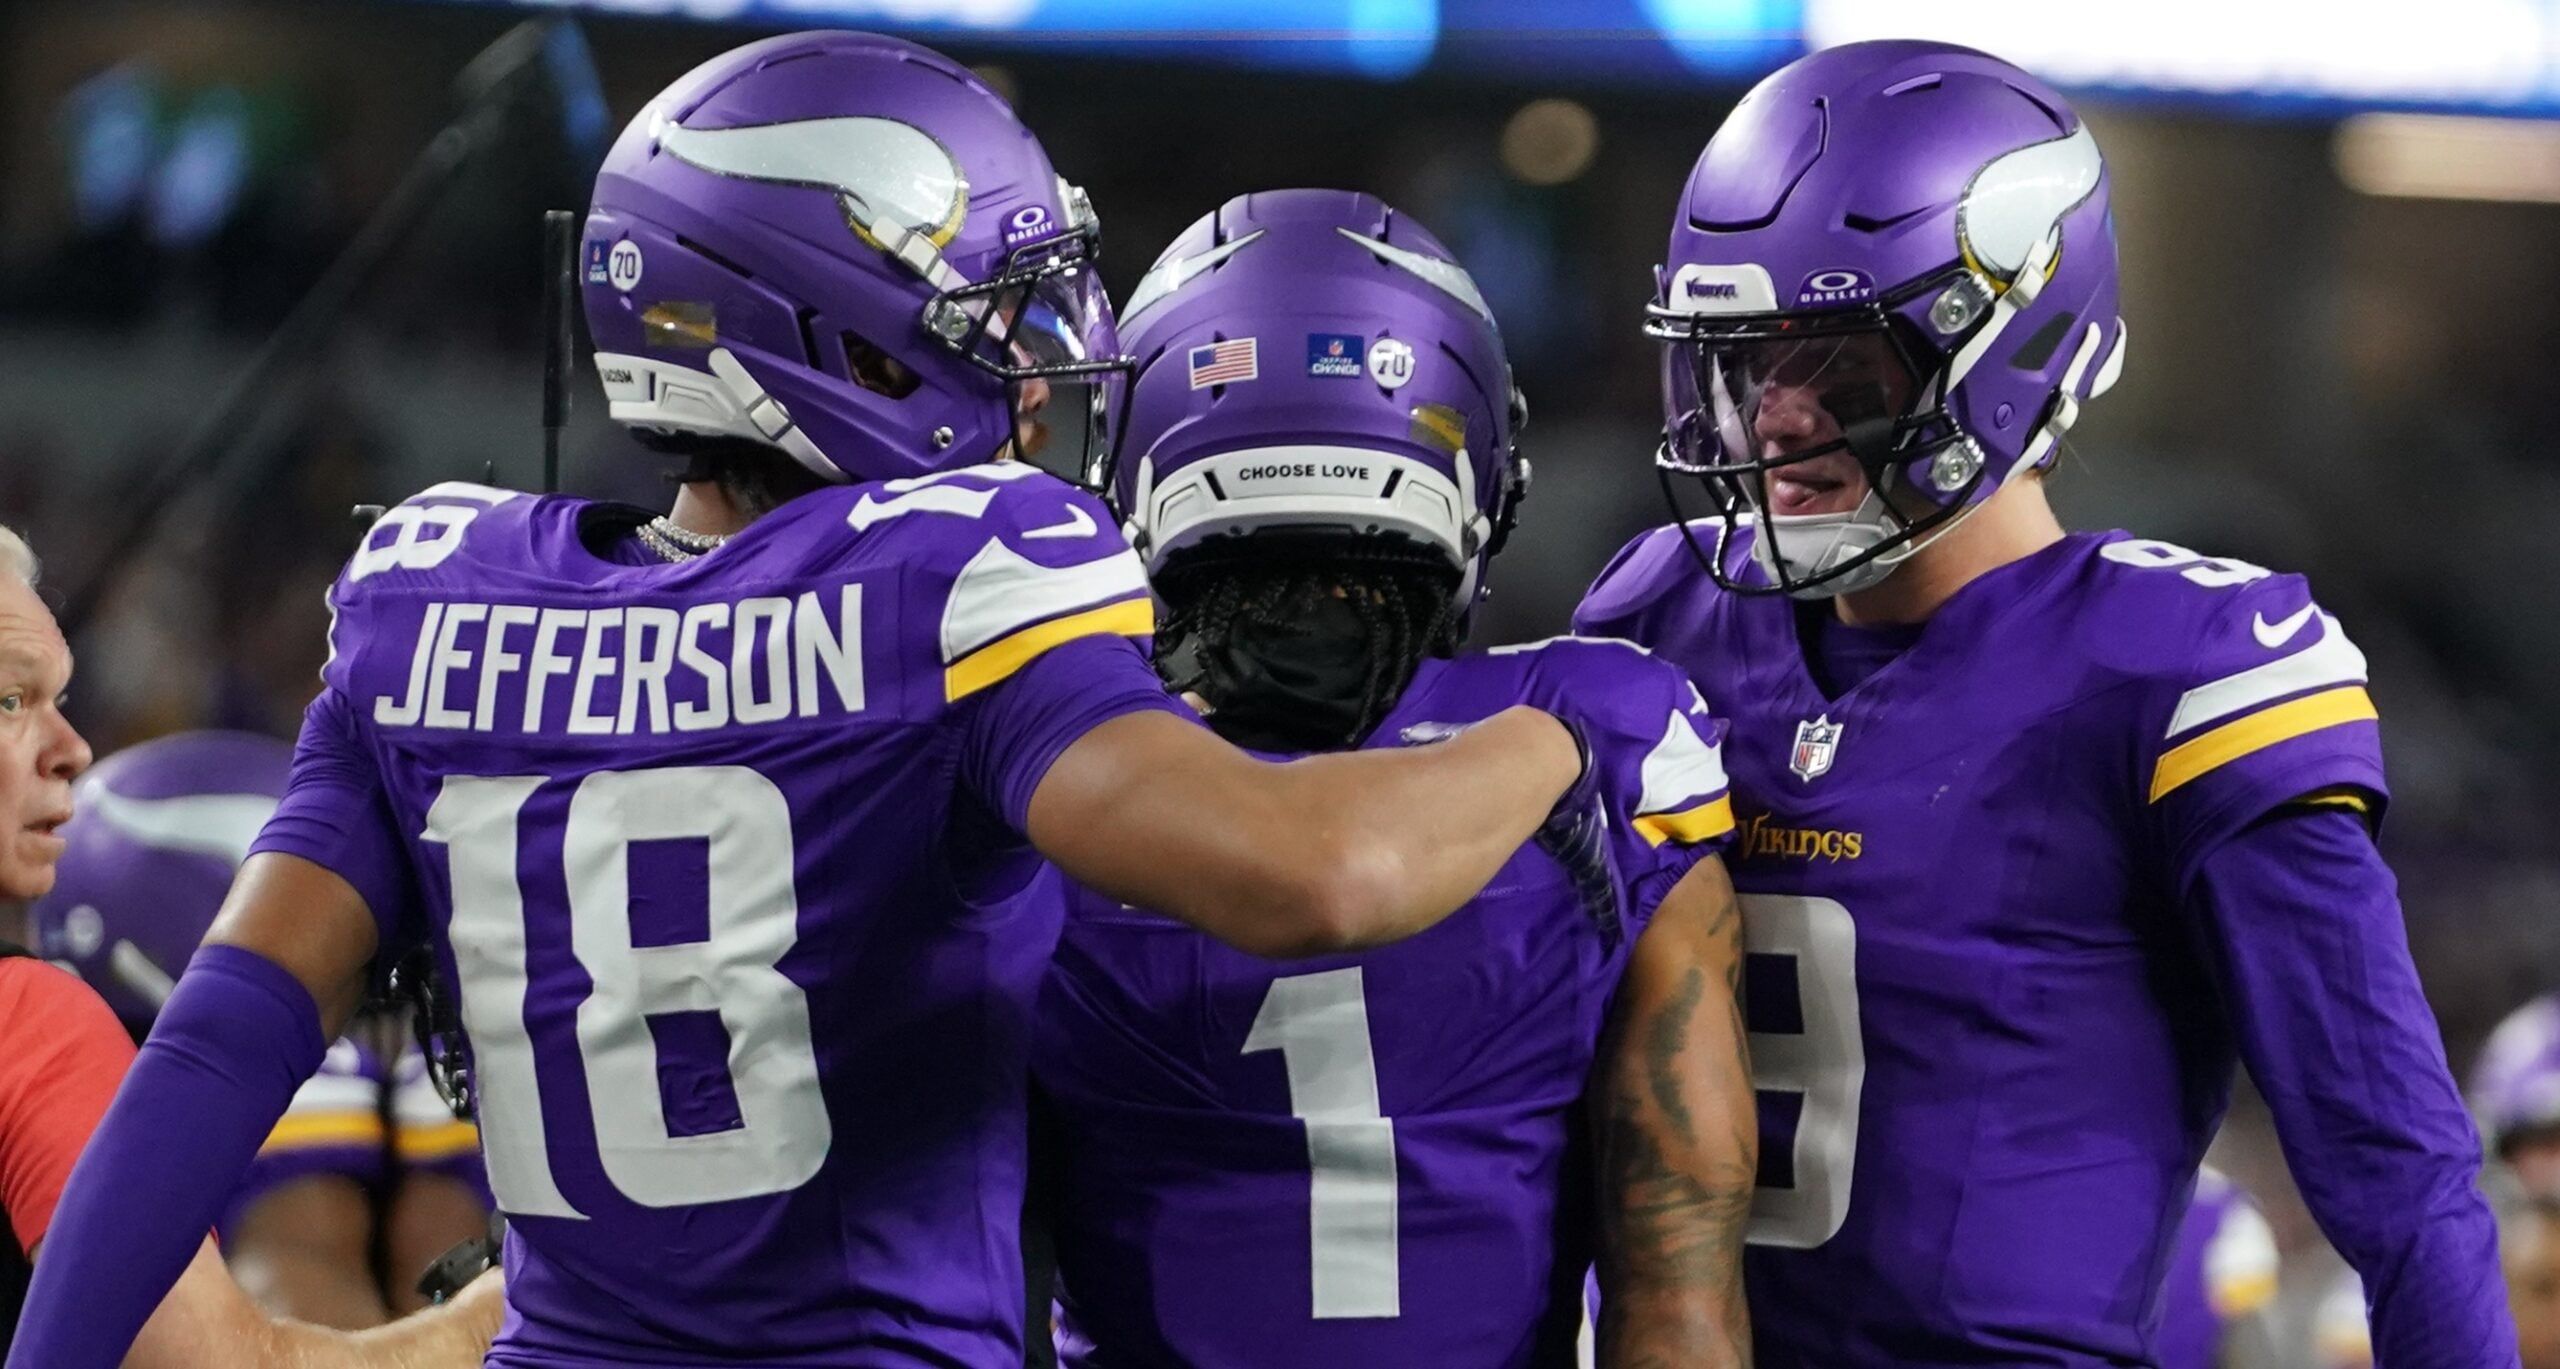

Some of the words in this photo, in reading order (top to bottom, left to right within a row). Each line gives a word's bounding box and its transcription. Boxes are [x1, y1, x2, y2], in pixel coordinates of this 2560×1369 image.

[1007, 221, 1054, 243] OAKLEY
[615, 251, 636, 279] 70
[1801, 288, 1870, 303] OAKLEY
[1312, 363, 1361, 375] CHANGE
[1377, 347, 1406, 377] 70
[1239, 464, 1315, 481] CHOOSE
[1322, 464, 1369, 480] LOVE
[349, 481, 519, 583] 18
[373, 583, 865, 735] JEFFERSON
[1797, 743, 1825, 772] NFL
[419, 765, 833, 1221] 18
[1240, 965, 1400, 1319] 1
